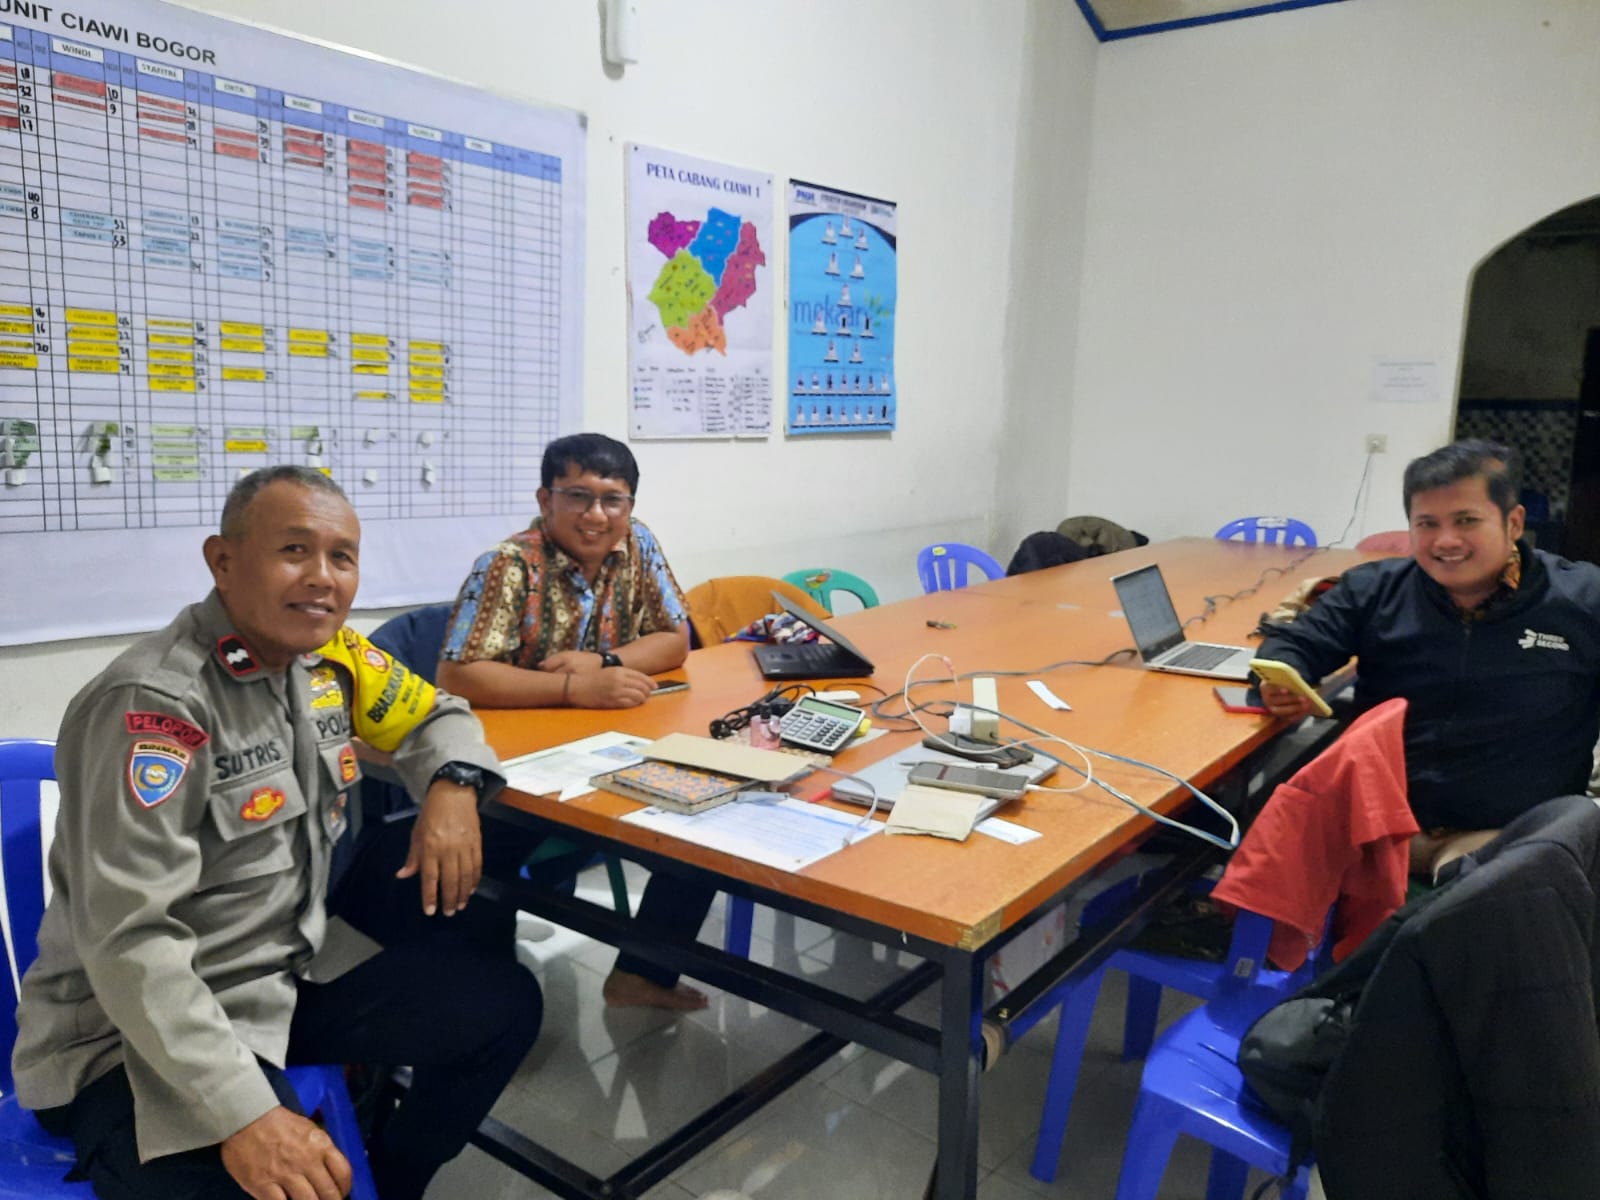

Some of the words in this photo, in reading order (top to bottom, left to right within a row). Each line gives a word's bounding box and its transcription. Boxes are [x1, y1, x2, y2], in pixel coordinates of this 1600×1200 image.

[0, 0, 53, 23] UNIT
[61, 12, 129, 44] CIAWI
[136, 31, 216, 65] BOGOR
[61, 43, 92, 58] WINDI
[646, 162, 675, 181] PETA
[678, 170, 721, 191] CABANG
[215, 740, 282, 780] SUTRIS
